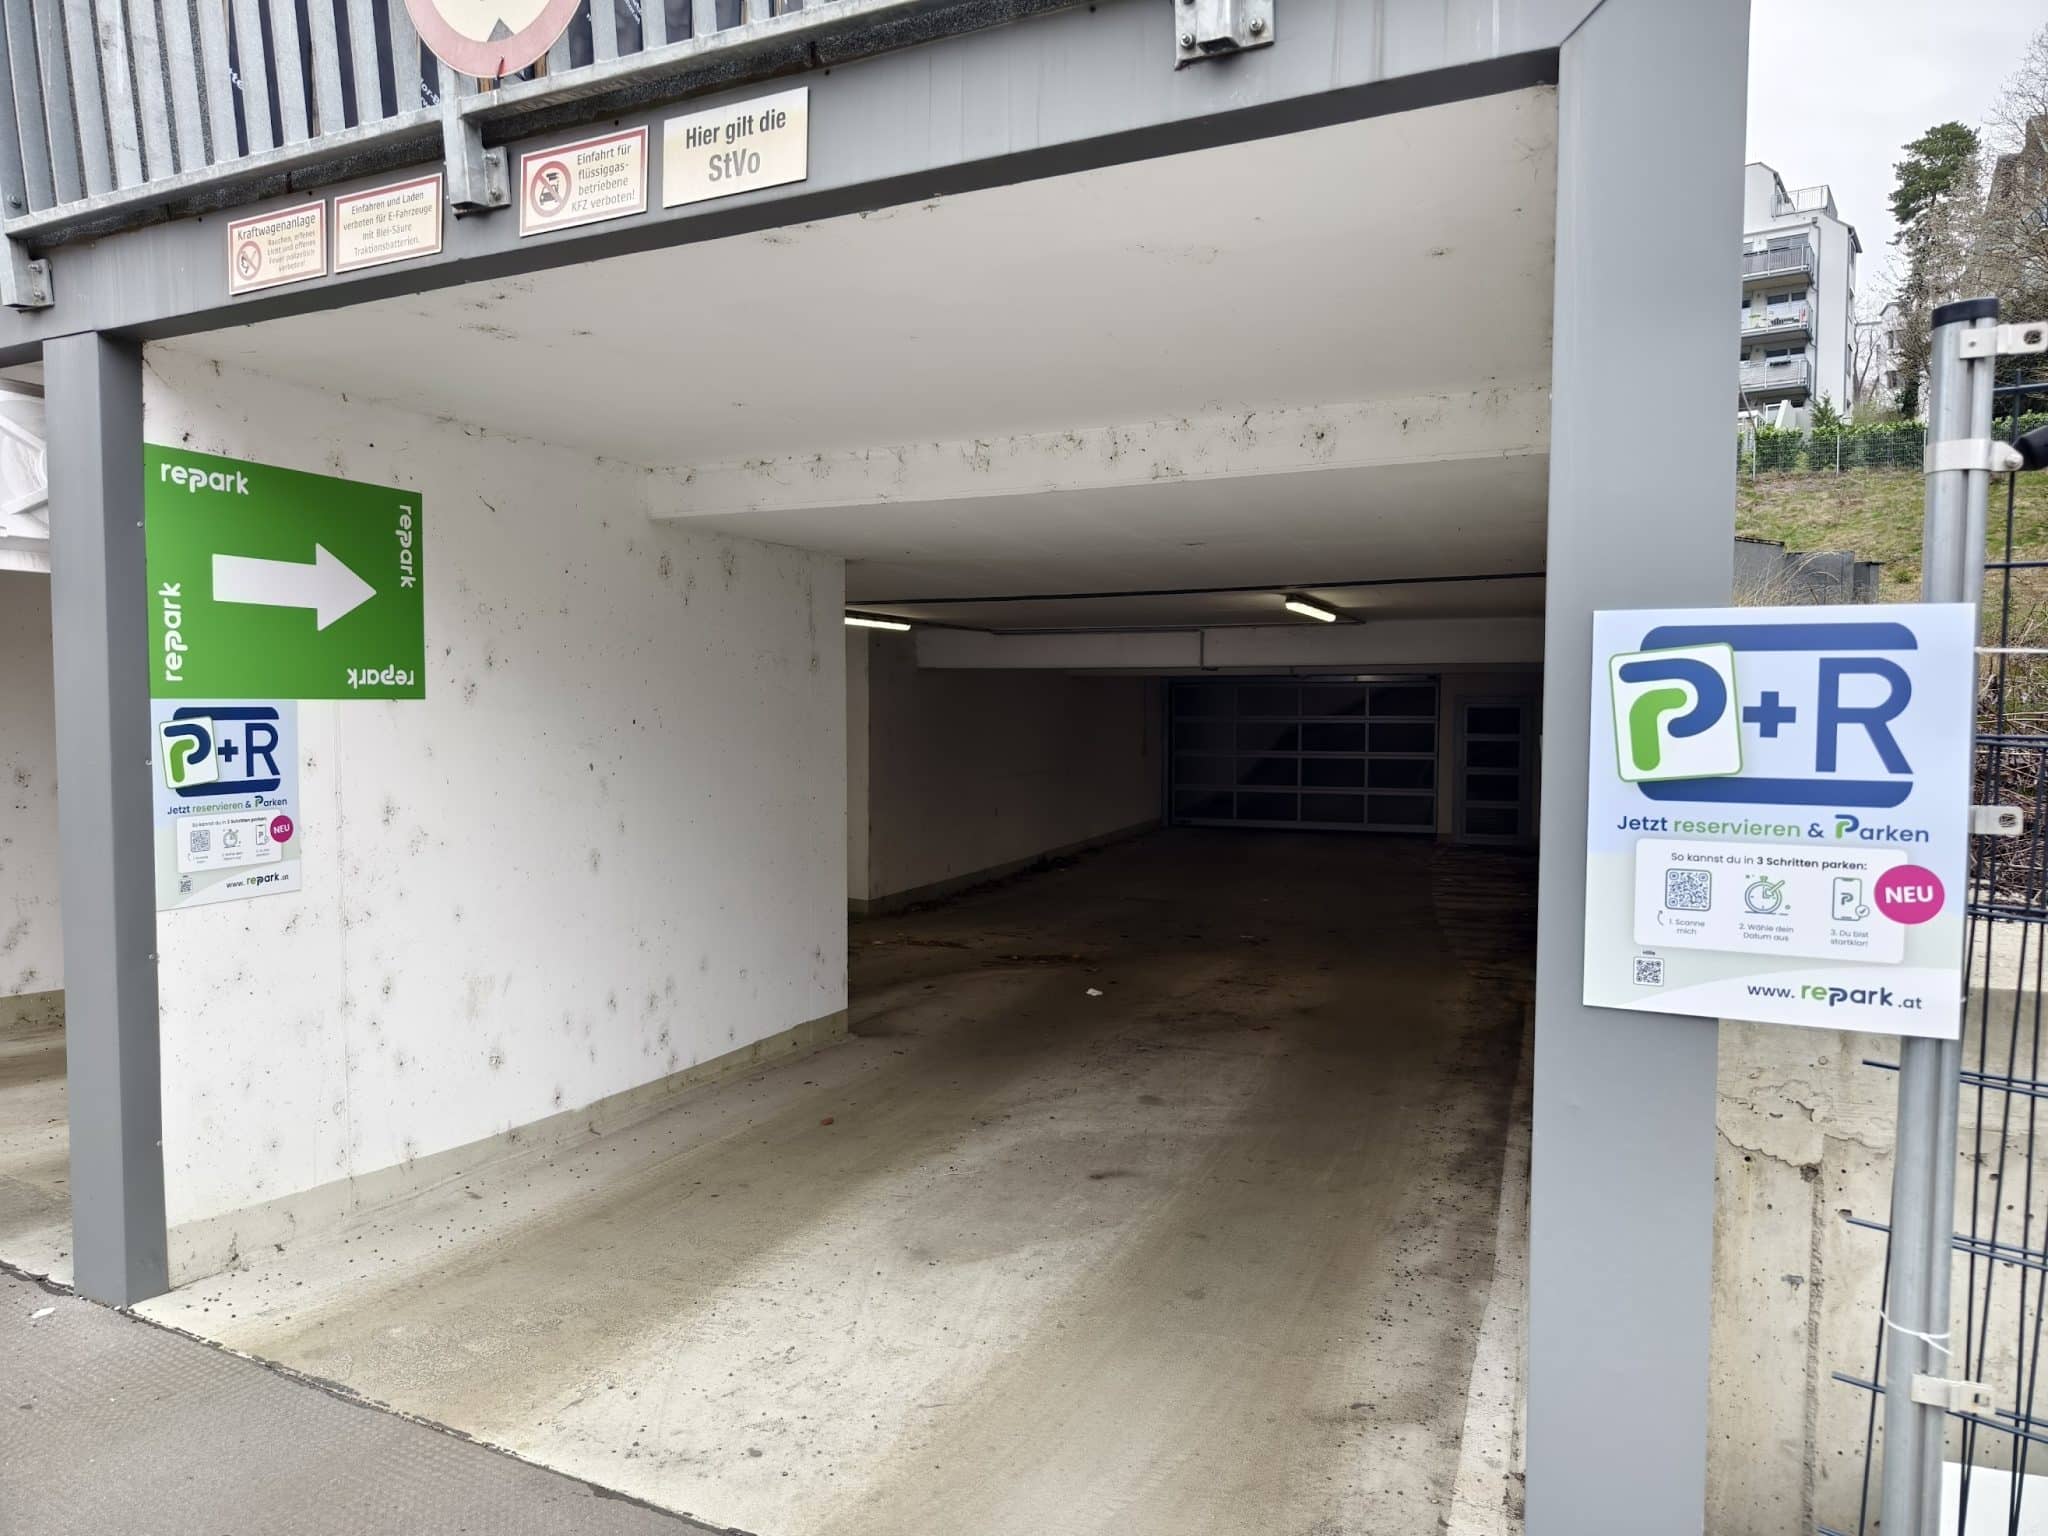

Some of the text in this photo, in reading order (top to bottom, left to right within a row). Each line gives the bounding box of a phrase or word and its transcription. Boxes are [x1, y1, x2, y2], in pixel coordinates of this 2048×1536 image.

[686, 109, 786, 149] Hier gilt die
[577, 143, 632, 165] Einfahrt für
[578, 162, 629, 180] flüssiggas-
[708, 148, 761, 182] StVo
[578, 177, 628, 196] betriebene
[351, 192, 424, 215] Einfahren und Laden
[571, 189, 635, 212] KFZ verboten!
[237, 214, 316, 241] Kraftwagenanlage
[343, 204, 433, 231] verboten für E-Fahrzeuge
[362, 231, 374, 241] mit
[160, 462, 249, 495] repark
[395, 504, 417, 588] repark
[158, 581, 188, 682] repark
[347, 664, 414, 689] repark
[167, 795, 288, 815] Jetzt reservieren & Parken
[273, 824, 290, 834] NEU
[1617, 814, 1930, 843] Jetzt reservieren & Parken
[1671, 852, 1868, 871] So kannst du in 3 Schritten parken:
[1884, 884, 1935, 905] NEU
[1676, 918, 1705, 927] Scanne
[1676, 927, 1697, 935] mich
[1775, 925, 1794, 934] dein
[1839, 929, 1852, 937] Du
[1743, 932, 1790, 942] Datum aus
